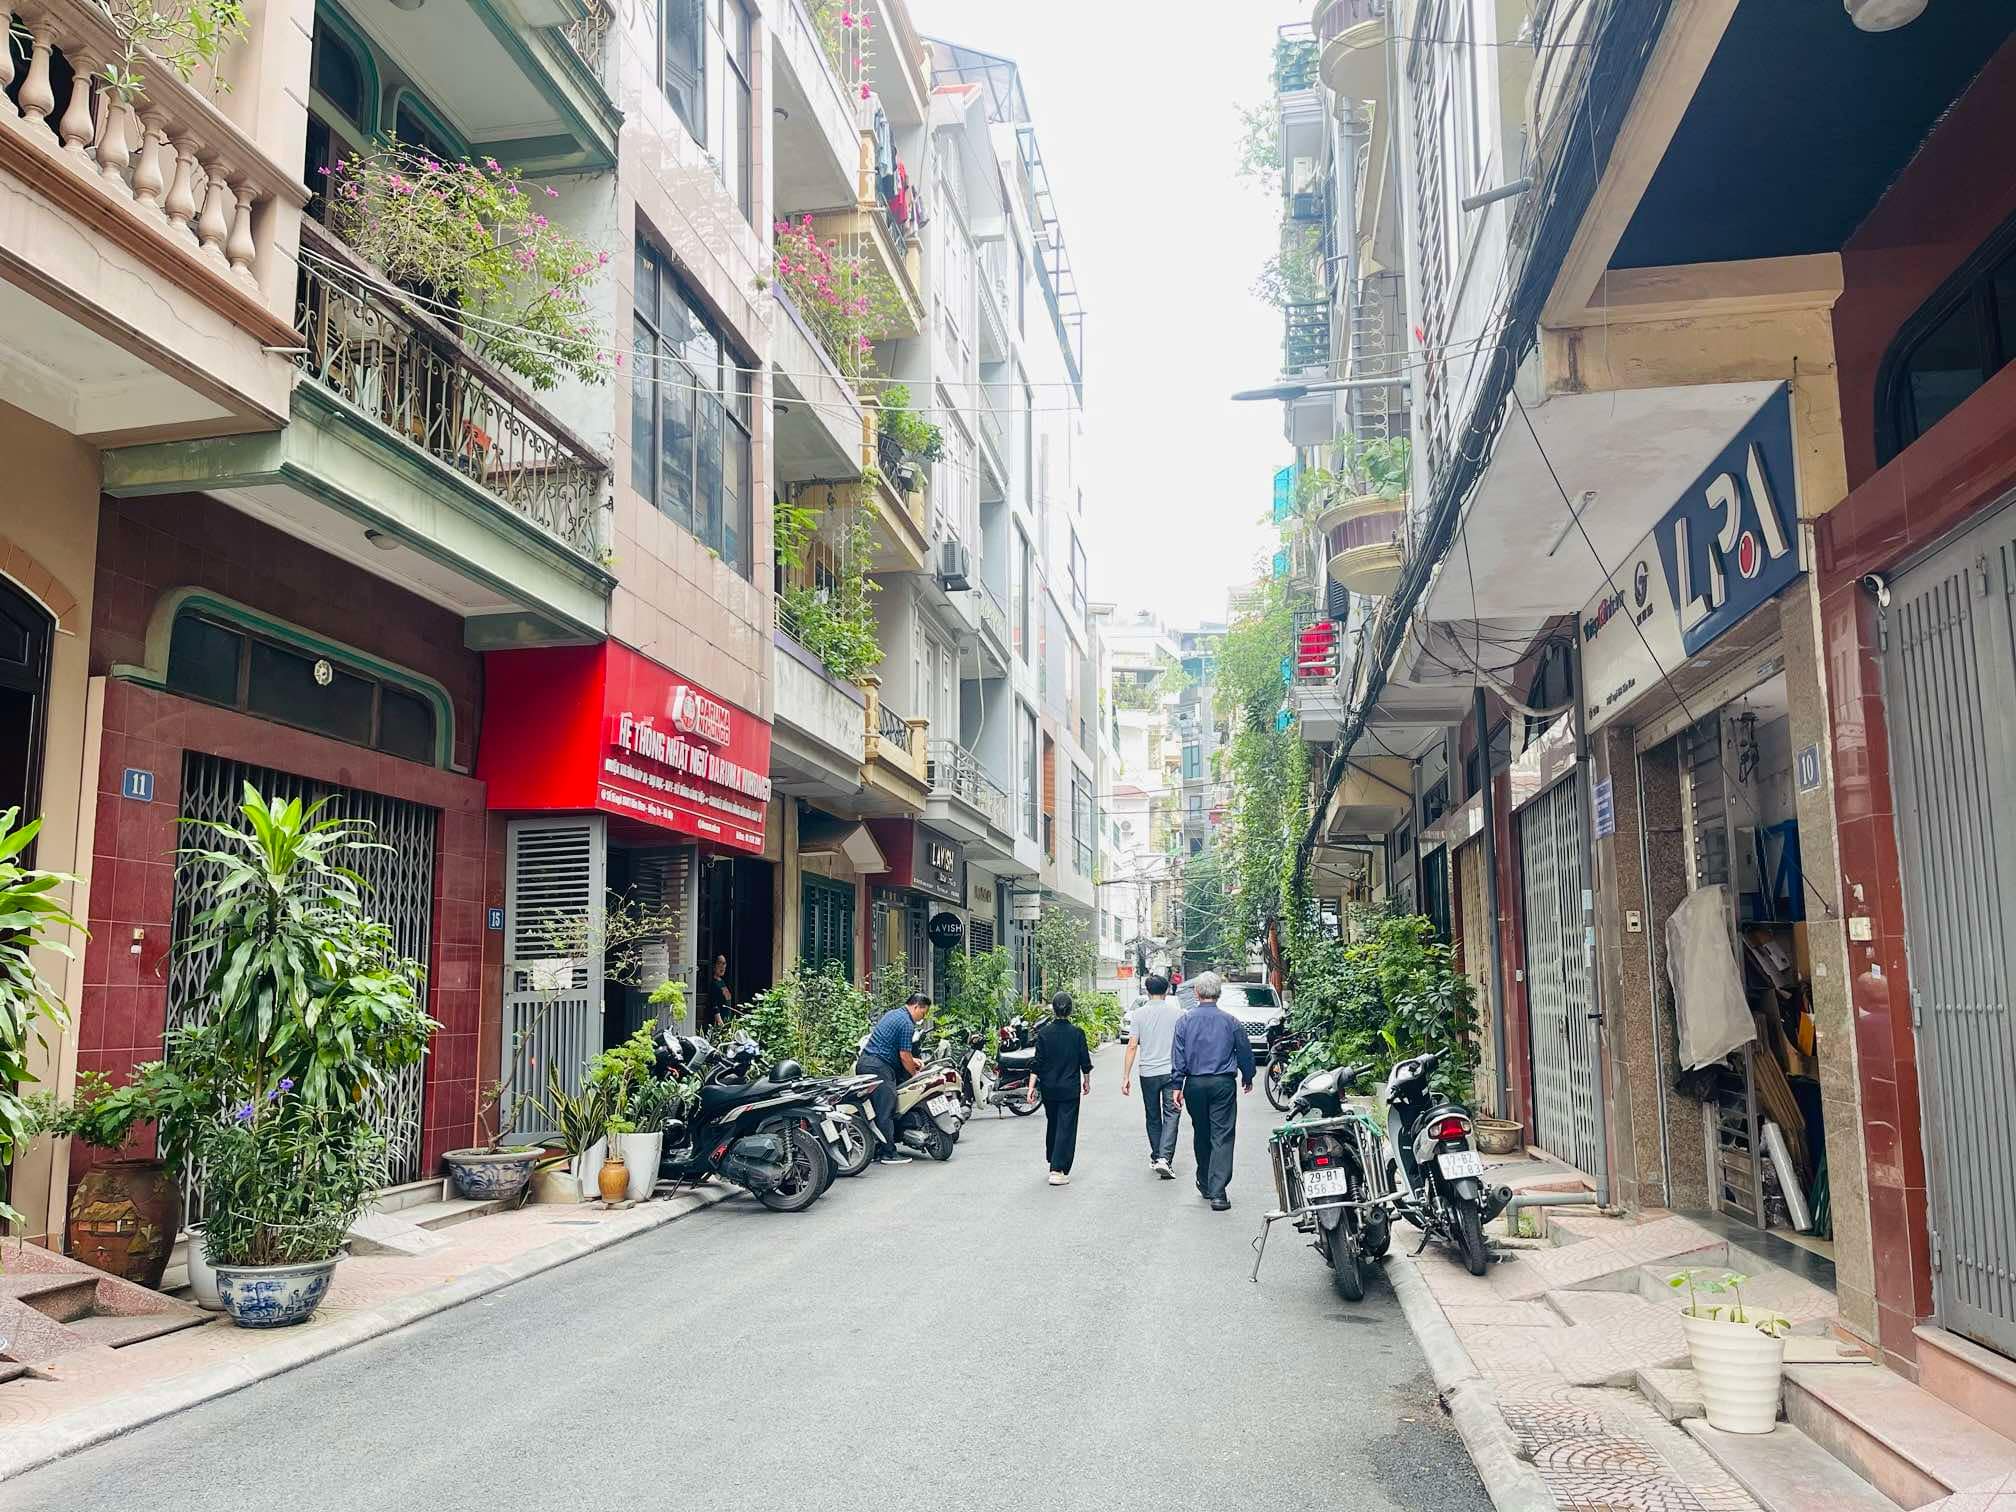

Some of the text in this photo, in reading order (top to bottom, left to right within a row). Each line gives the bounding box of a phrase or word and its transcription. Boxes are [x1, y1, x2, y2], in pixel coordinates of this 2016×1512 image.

[699, 699, 730, 728] DARUMA
[709, 754, 742, 793] DARUMA
[1802, 754, 1814, 785] 10
[132, 773, 146, 796] 11
[932, 842, 954, 873] LAVISH
[492, 911, 501, 928] 15
[929, 922, 962, 934] LAVISH
[1309, 1168, 1339, 1185] 29-B1
